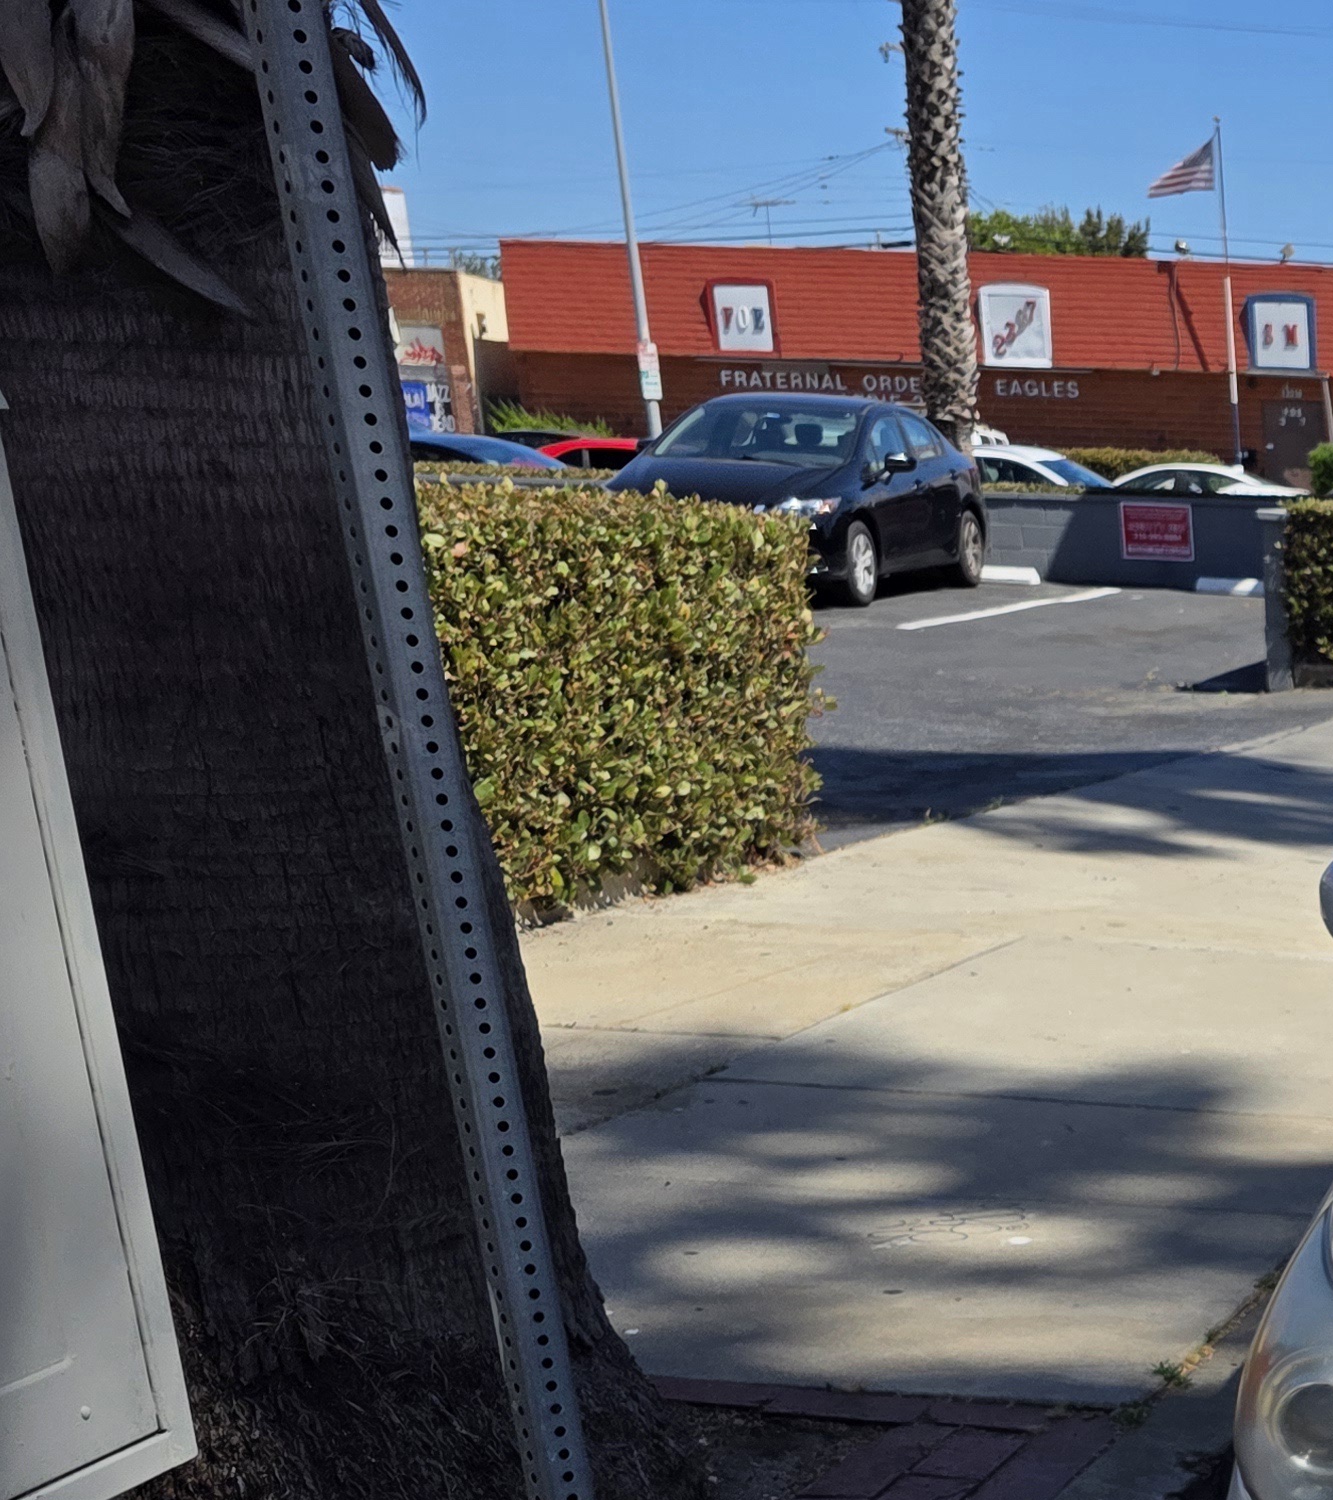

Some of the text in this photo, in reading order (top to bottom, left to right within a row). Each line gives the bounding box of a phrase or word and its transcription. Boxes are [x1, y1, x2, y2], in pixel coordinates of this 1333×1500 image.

[719, 369, 1080, 400] FRATERNAL ORDE EAGLES
